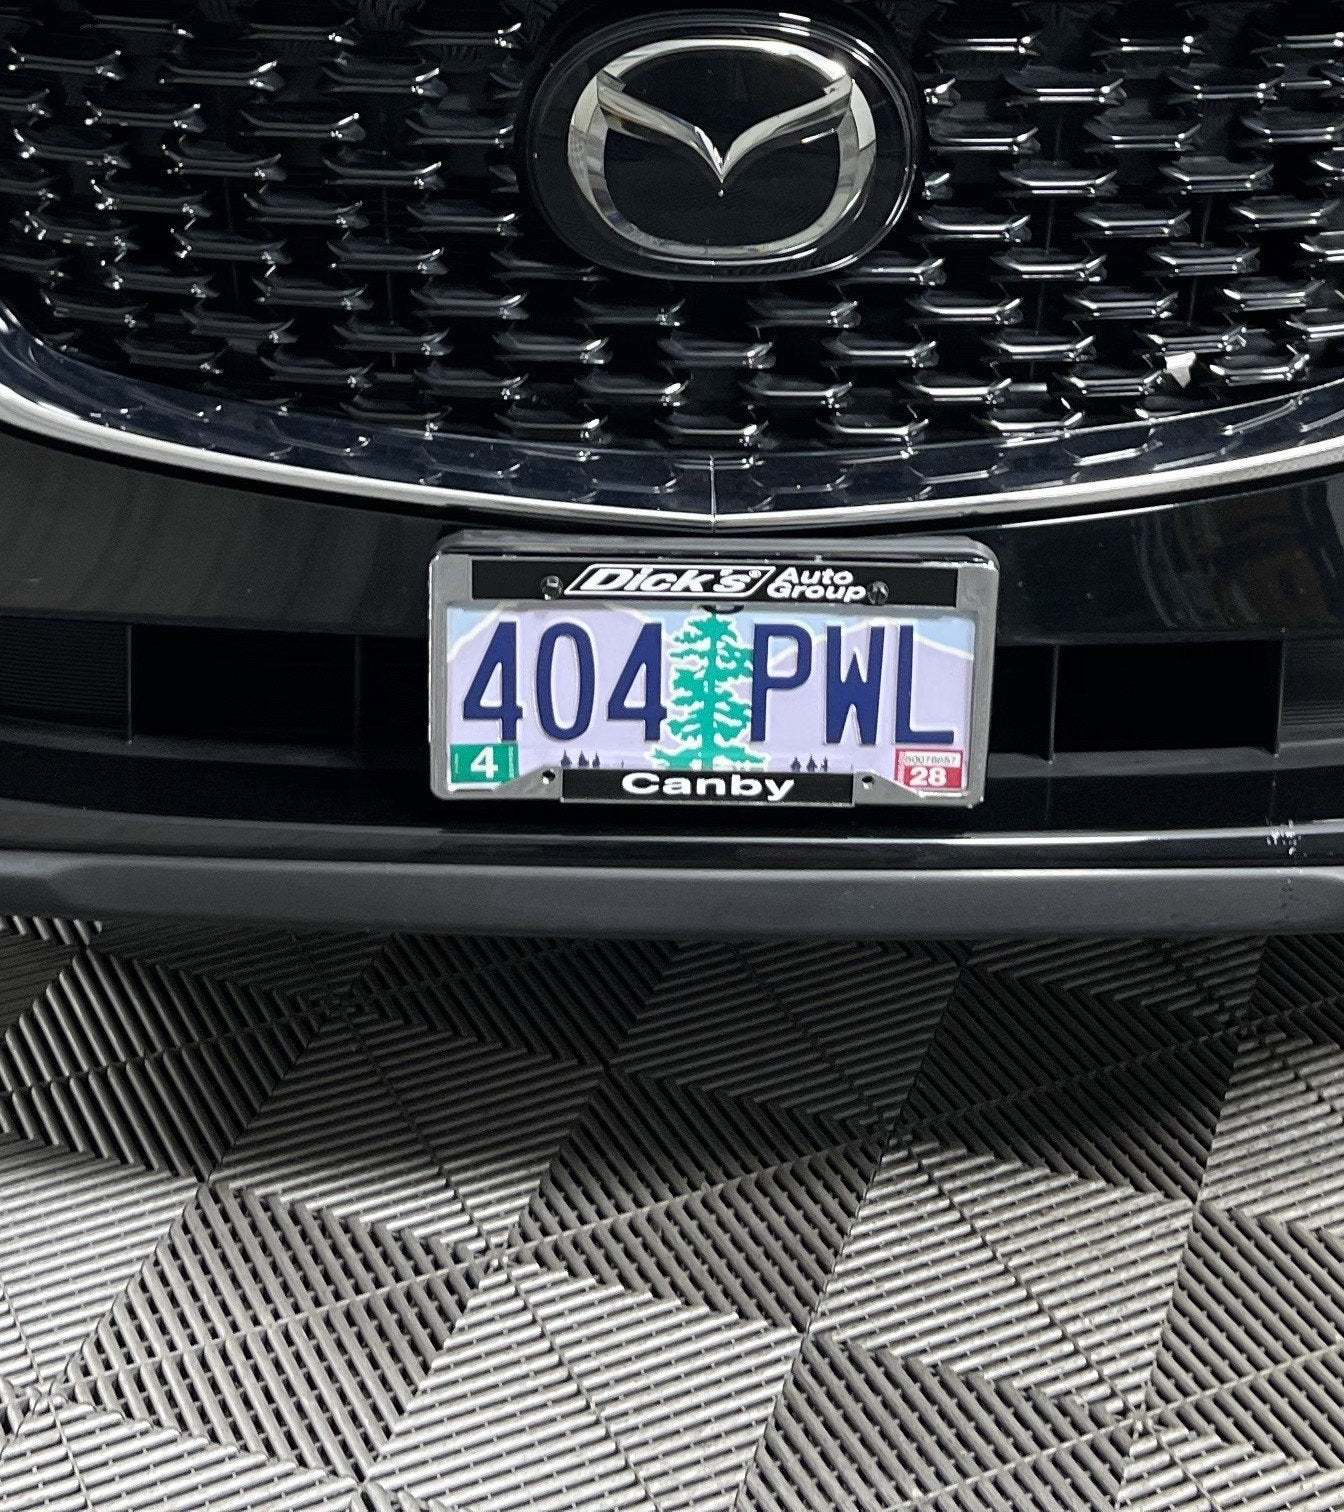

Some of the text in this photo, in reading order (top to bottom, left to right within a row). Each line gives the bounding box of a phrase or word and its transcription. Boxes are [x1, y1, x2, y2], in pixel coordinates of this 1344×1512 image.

[580, 567, 752, 593] Dick's
[774, 567, 854, 585] Auto
[766, 582, 867, 603] Group
[462, 620, 955, 745] 404 PWL
[470, 746, 499, 780] 4
[622, 772, 795, 801] Canby
[909, 766, 947, 787] 28
